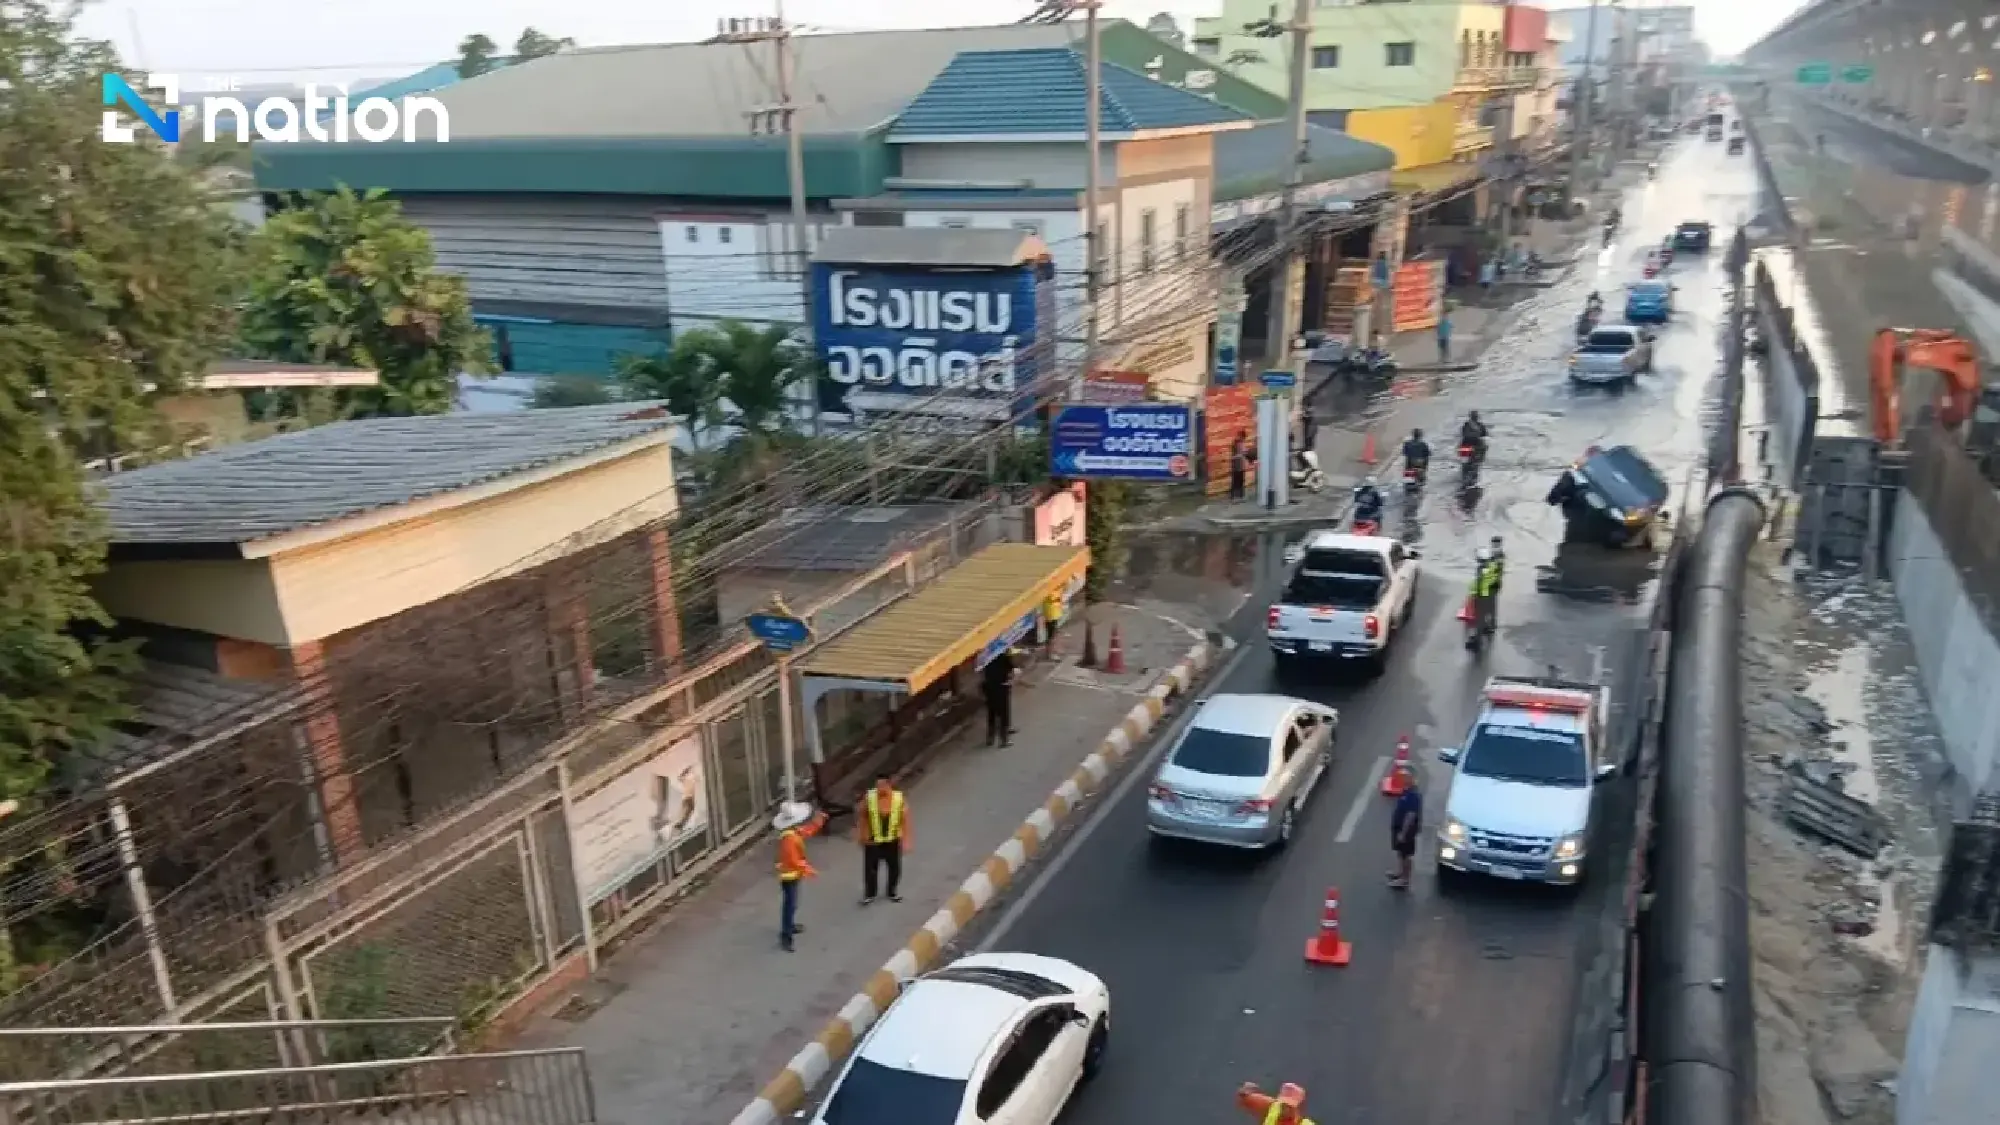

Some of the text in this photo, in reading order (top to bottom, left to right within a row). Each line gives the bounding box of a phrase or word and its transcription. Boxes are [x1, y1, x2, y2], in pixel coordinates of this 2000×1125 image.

[829, 270, 1013, 334] โรงแรม
[1105, 407, 1186, 429] โรงแรม
